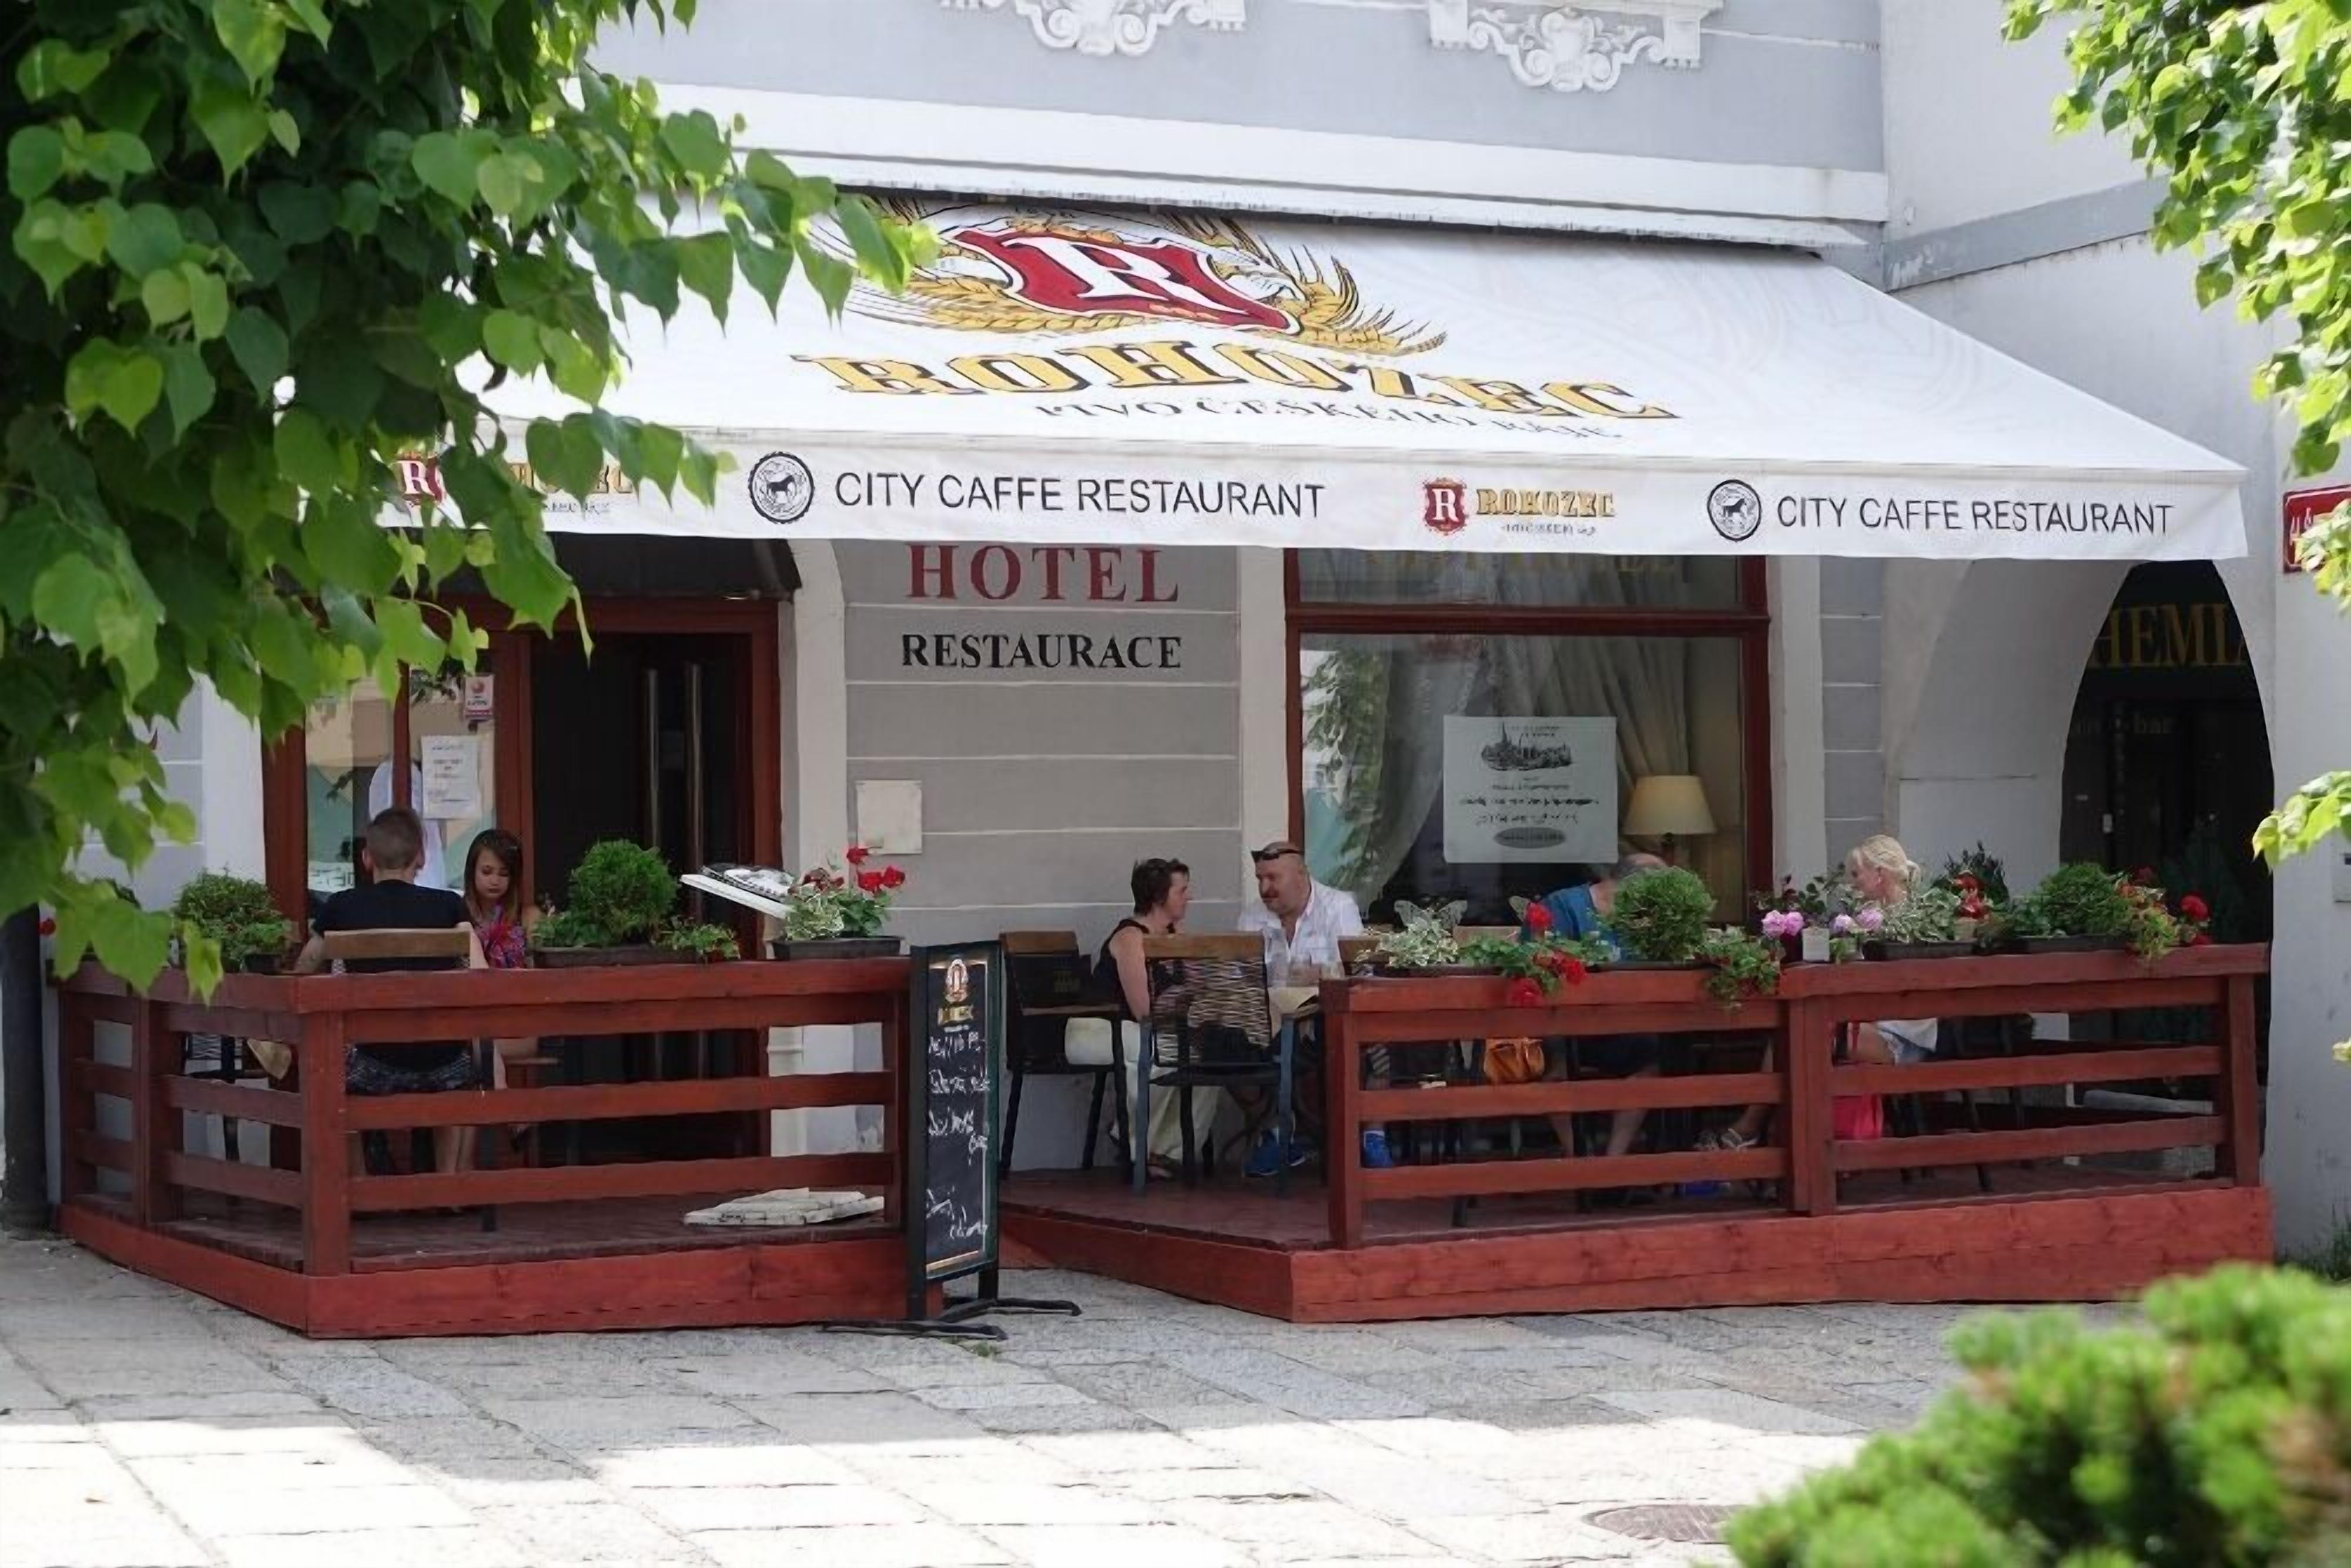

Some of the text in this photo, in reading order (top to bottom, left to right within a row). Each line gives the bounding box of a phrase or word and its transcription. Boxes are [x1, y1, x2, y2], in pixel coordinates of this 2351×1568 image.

[835, 472, 925, 508] CITY
[939, 474, 1064, 511] CAFFE
[1078, 478, 1326, 517] RESTAURANT
[1432, 488, 1459, 522] R
[1777, 496, 1847, 527] CITY
[1859, 498, 1962, 530] CAFFE
[1972, 501, 2175, 532] RESTAURANT
[906, 542, 1178, 602] HOTEL
[901, 634, 1181, 668] RESTAURACE
[2088, 603, 2248, 668] HEMI
